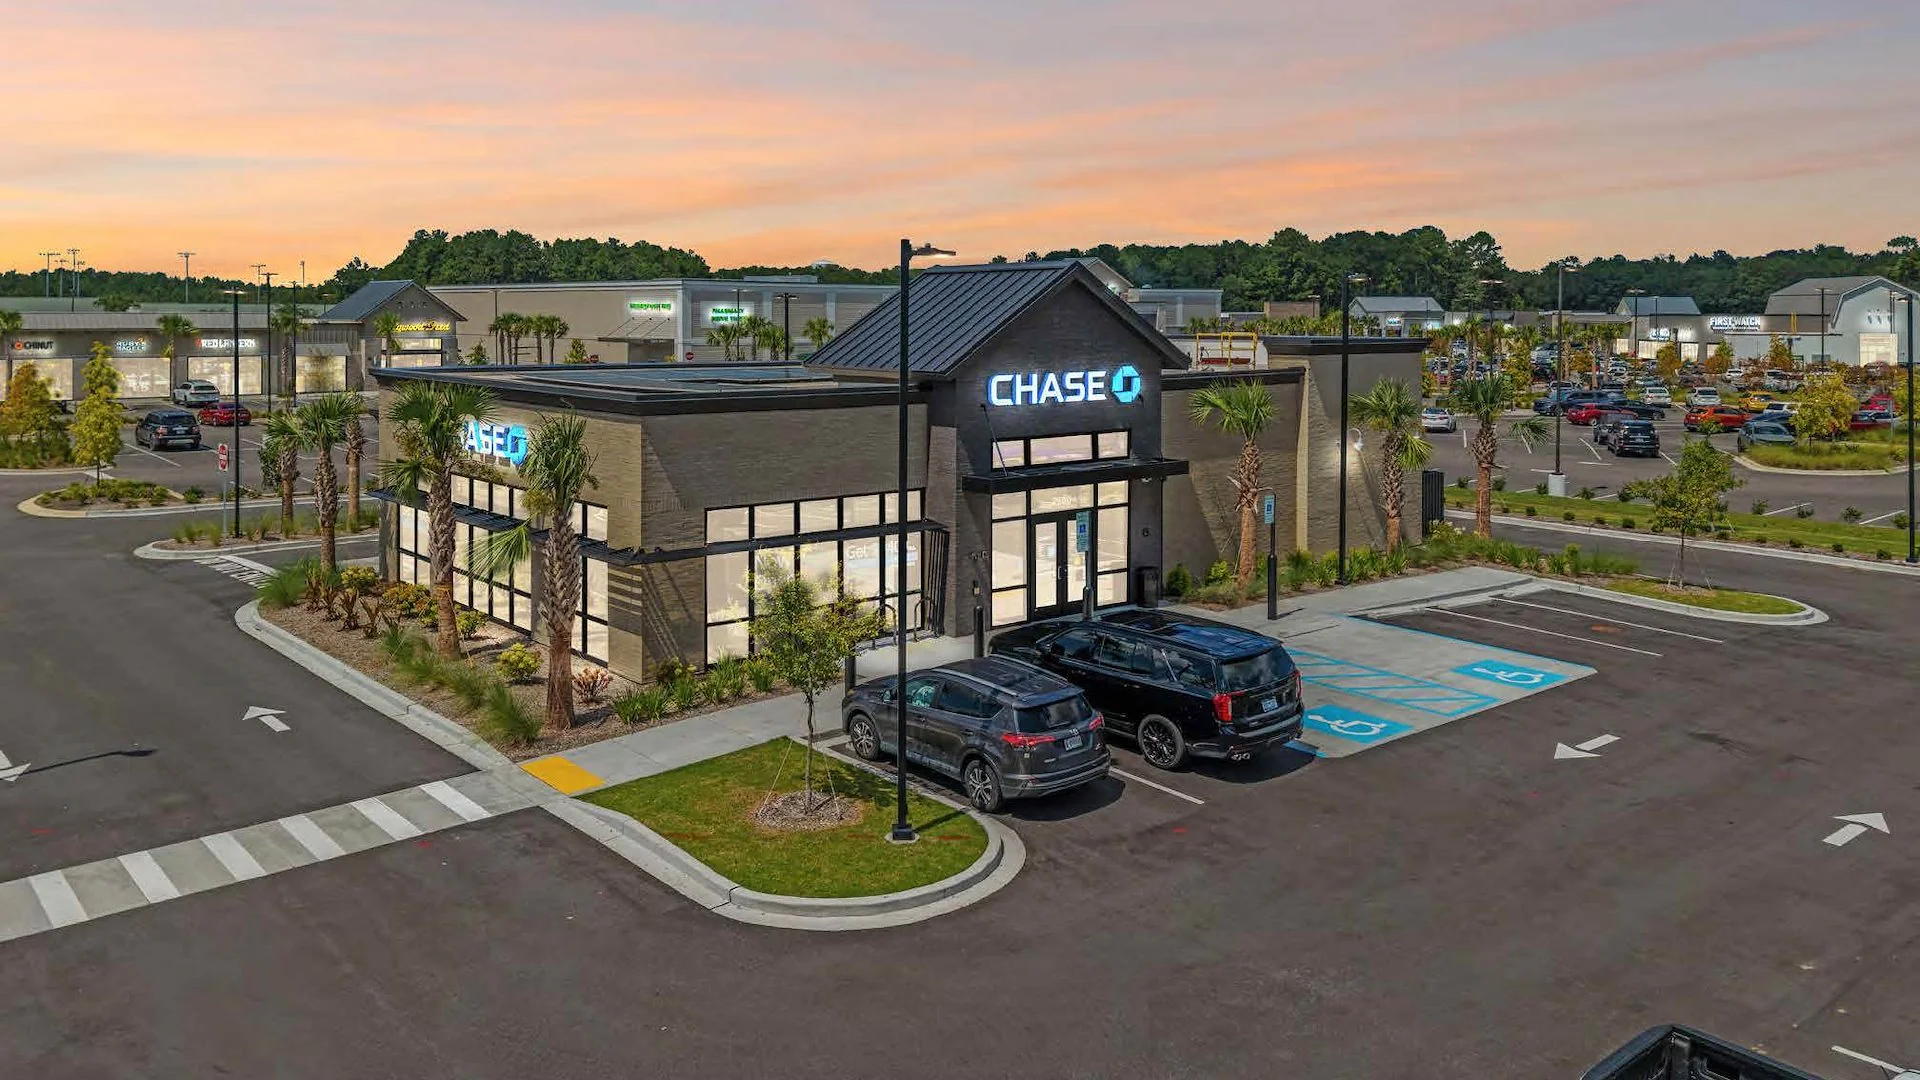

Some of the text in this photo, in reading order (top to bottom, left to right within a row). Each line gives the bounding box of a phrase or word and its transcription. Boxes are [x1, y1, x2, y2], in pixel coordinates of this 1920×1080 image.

[1709, 316, 1761, 326] FIRST WATCH
[202, 339, 256, 348] RED LANERN
[986, 370, 1107, 406] CHASE
[461, 419, 510, 458] ASE
